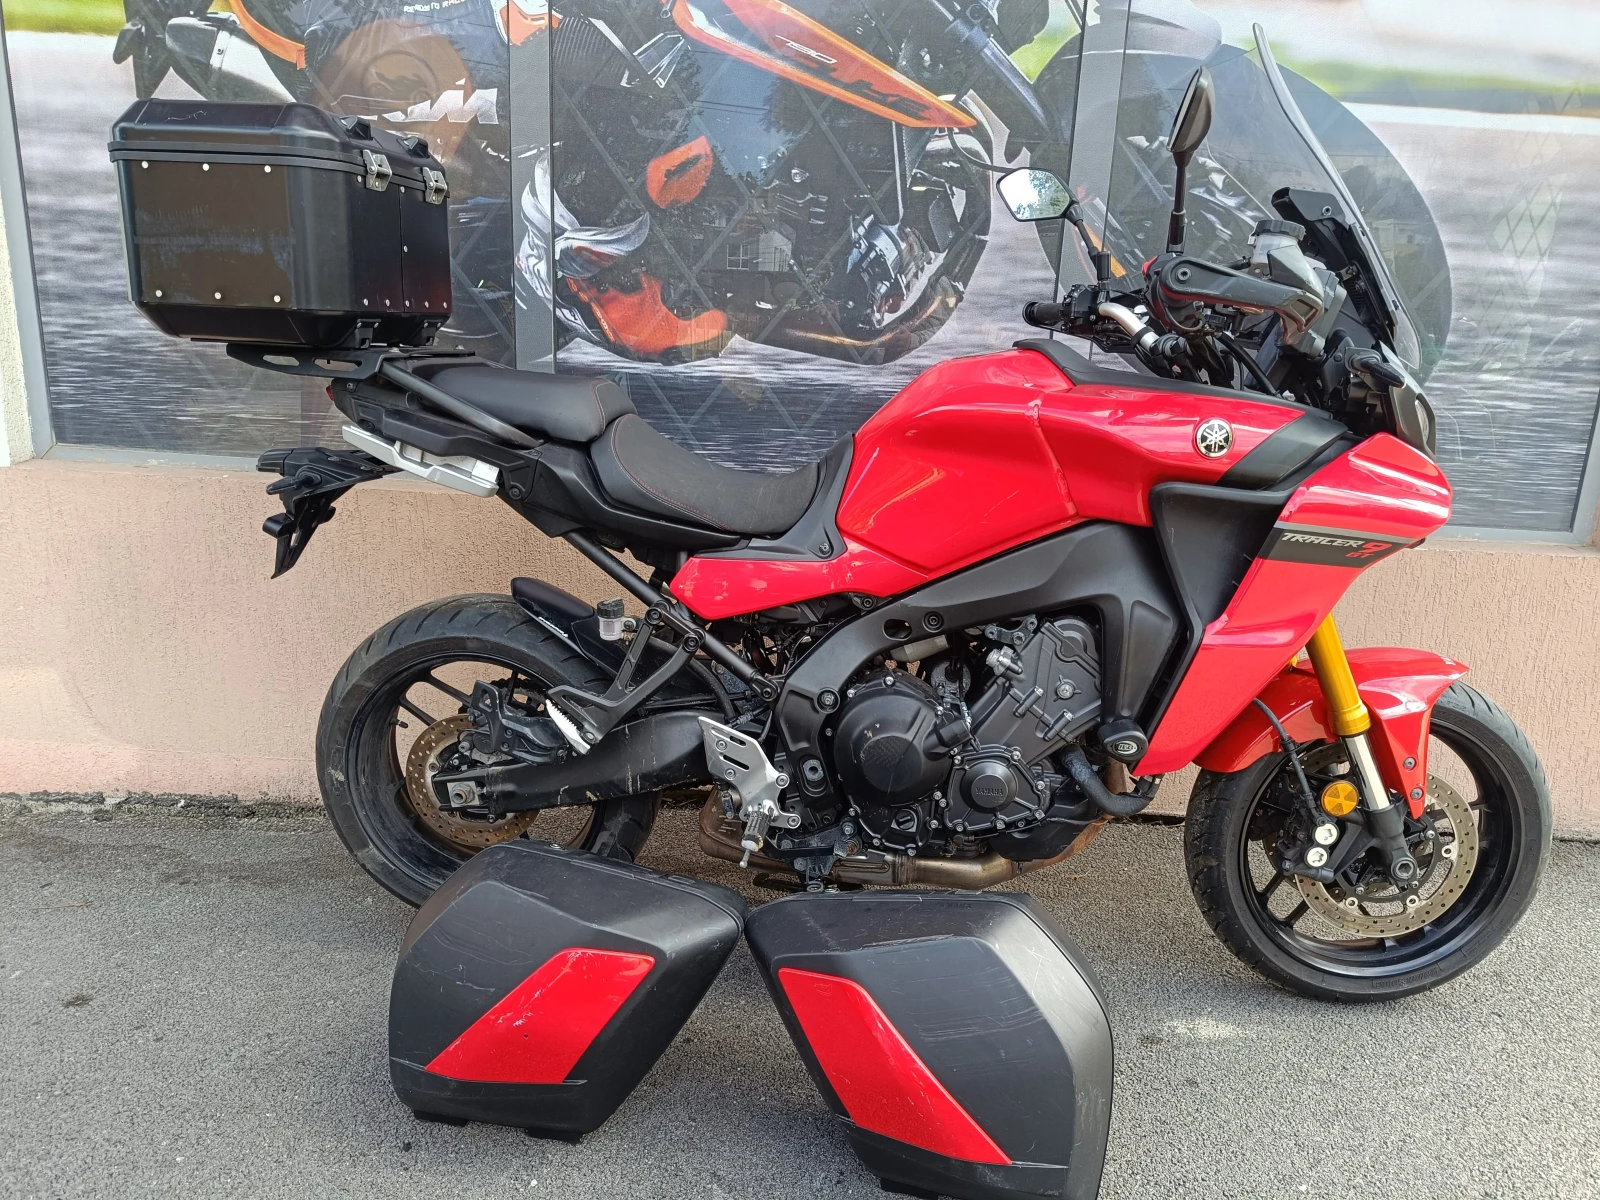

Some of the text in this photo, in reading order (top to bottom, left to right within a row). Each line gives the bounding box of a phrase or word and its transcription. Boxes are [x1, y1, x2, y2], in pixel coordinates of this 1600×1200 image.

[1281, 532, 1393, 554] TRACER 9
[1345, 551, 1375, 559] GT
[975, 787, 1004, 797] YAMAHA
